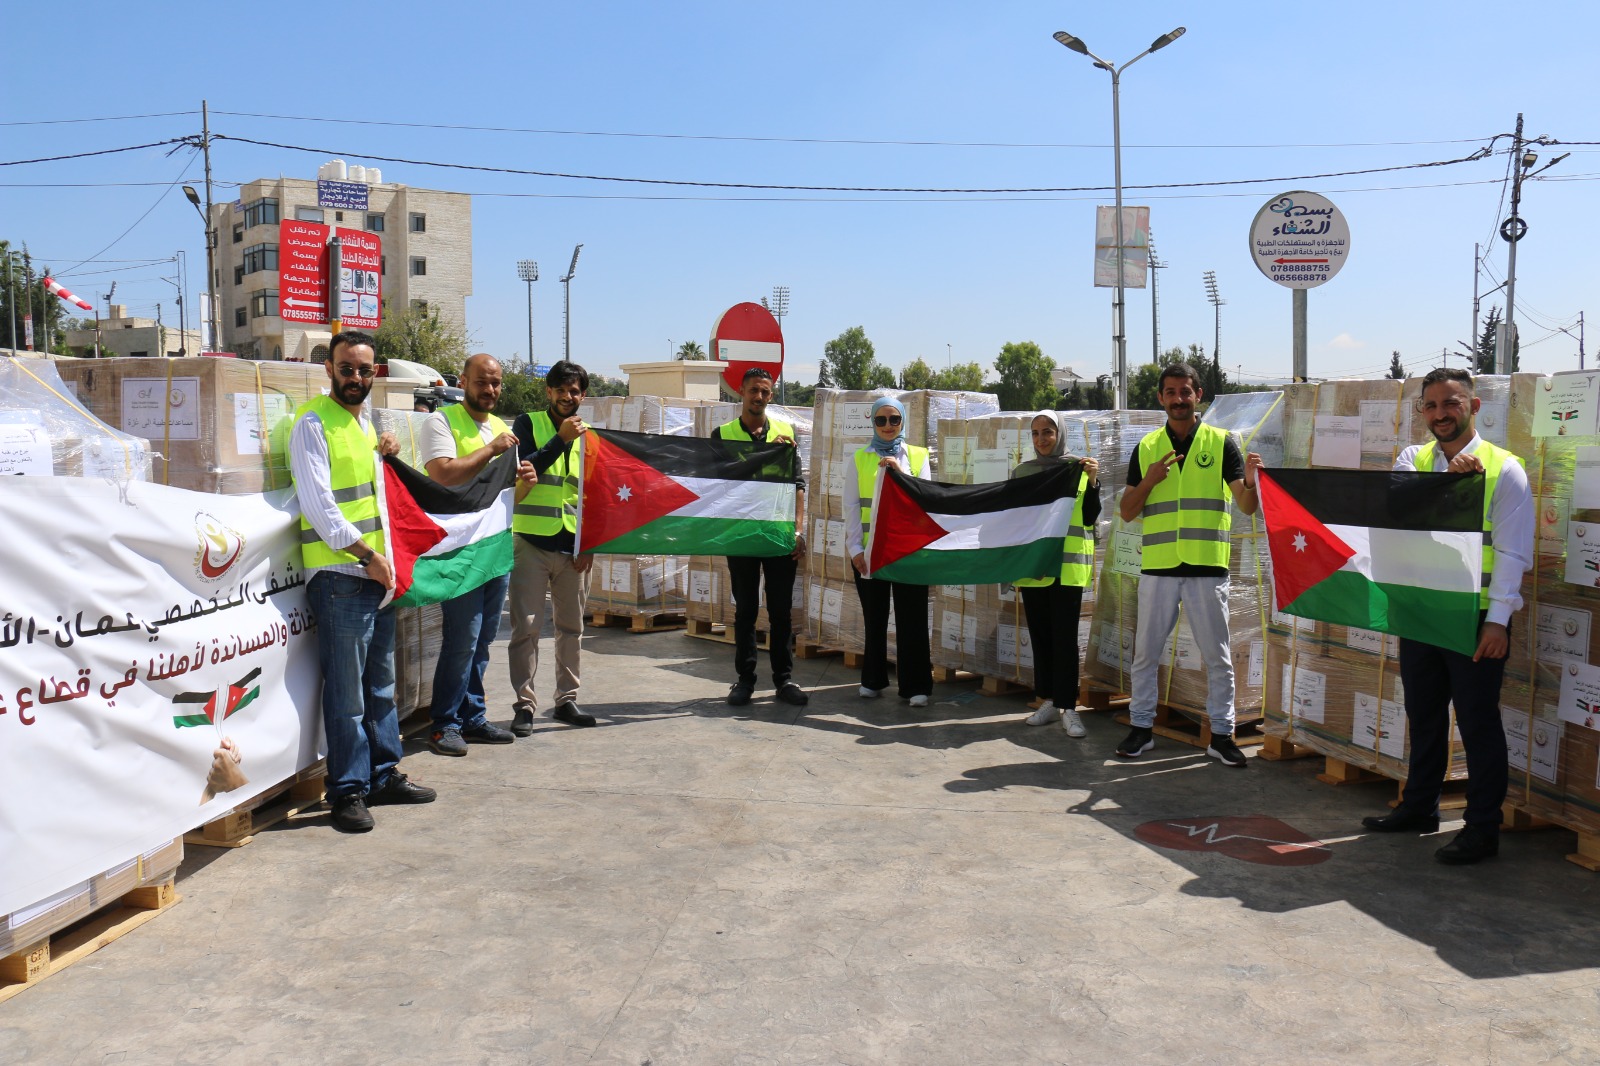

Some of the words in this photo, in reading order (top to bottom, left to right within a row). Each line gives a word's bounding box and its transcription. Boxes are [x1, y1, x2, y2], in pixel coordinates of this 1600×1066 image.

[288, 239, 322, 248] المعرض
[361, 237, 376, 253] بسمة
[292, 250, 317, 261] بسمة
[341, 252, 357, 265] الطبي
[290, 264, 318, 272] الشفاء
[284, 274, 309, 283] الجهة
[288, 287, 321, 296] المقابلة
[282, 309, 325, 320] 0785555755
[252, 562, 305, 604] شفى
[141, 581, 251, 642] التخصصي
[211, 622, 287, 665] والمساندة
[146, 641, 205, 681] لأهلنا
[100, 660, 138, 708] في
[16, 668, 91, 726] قطاع
